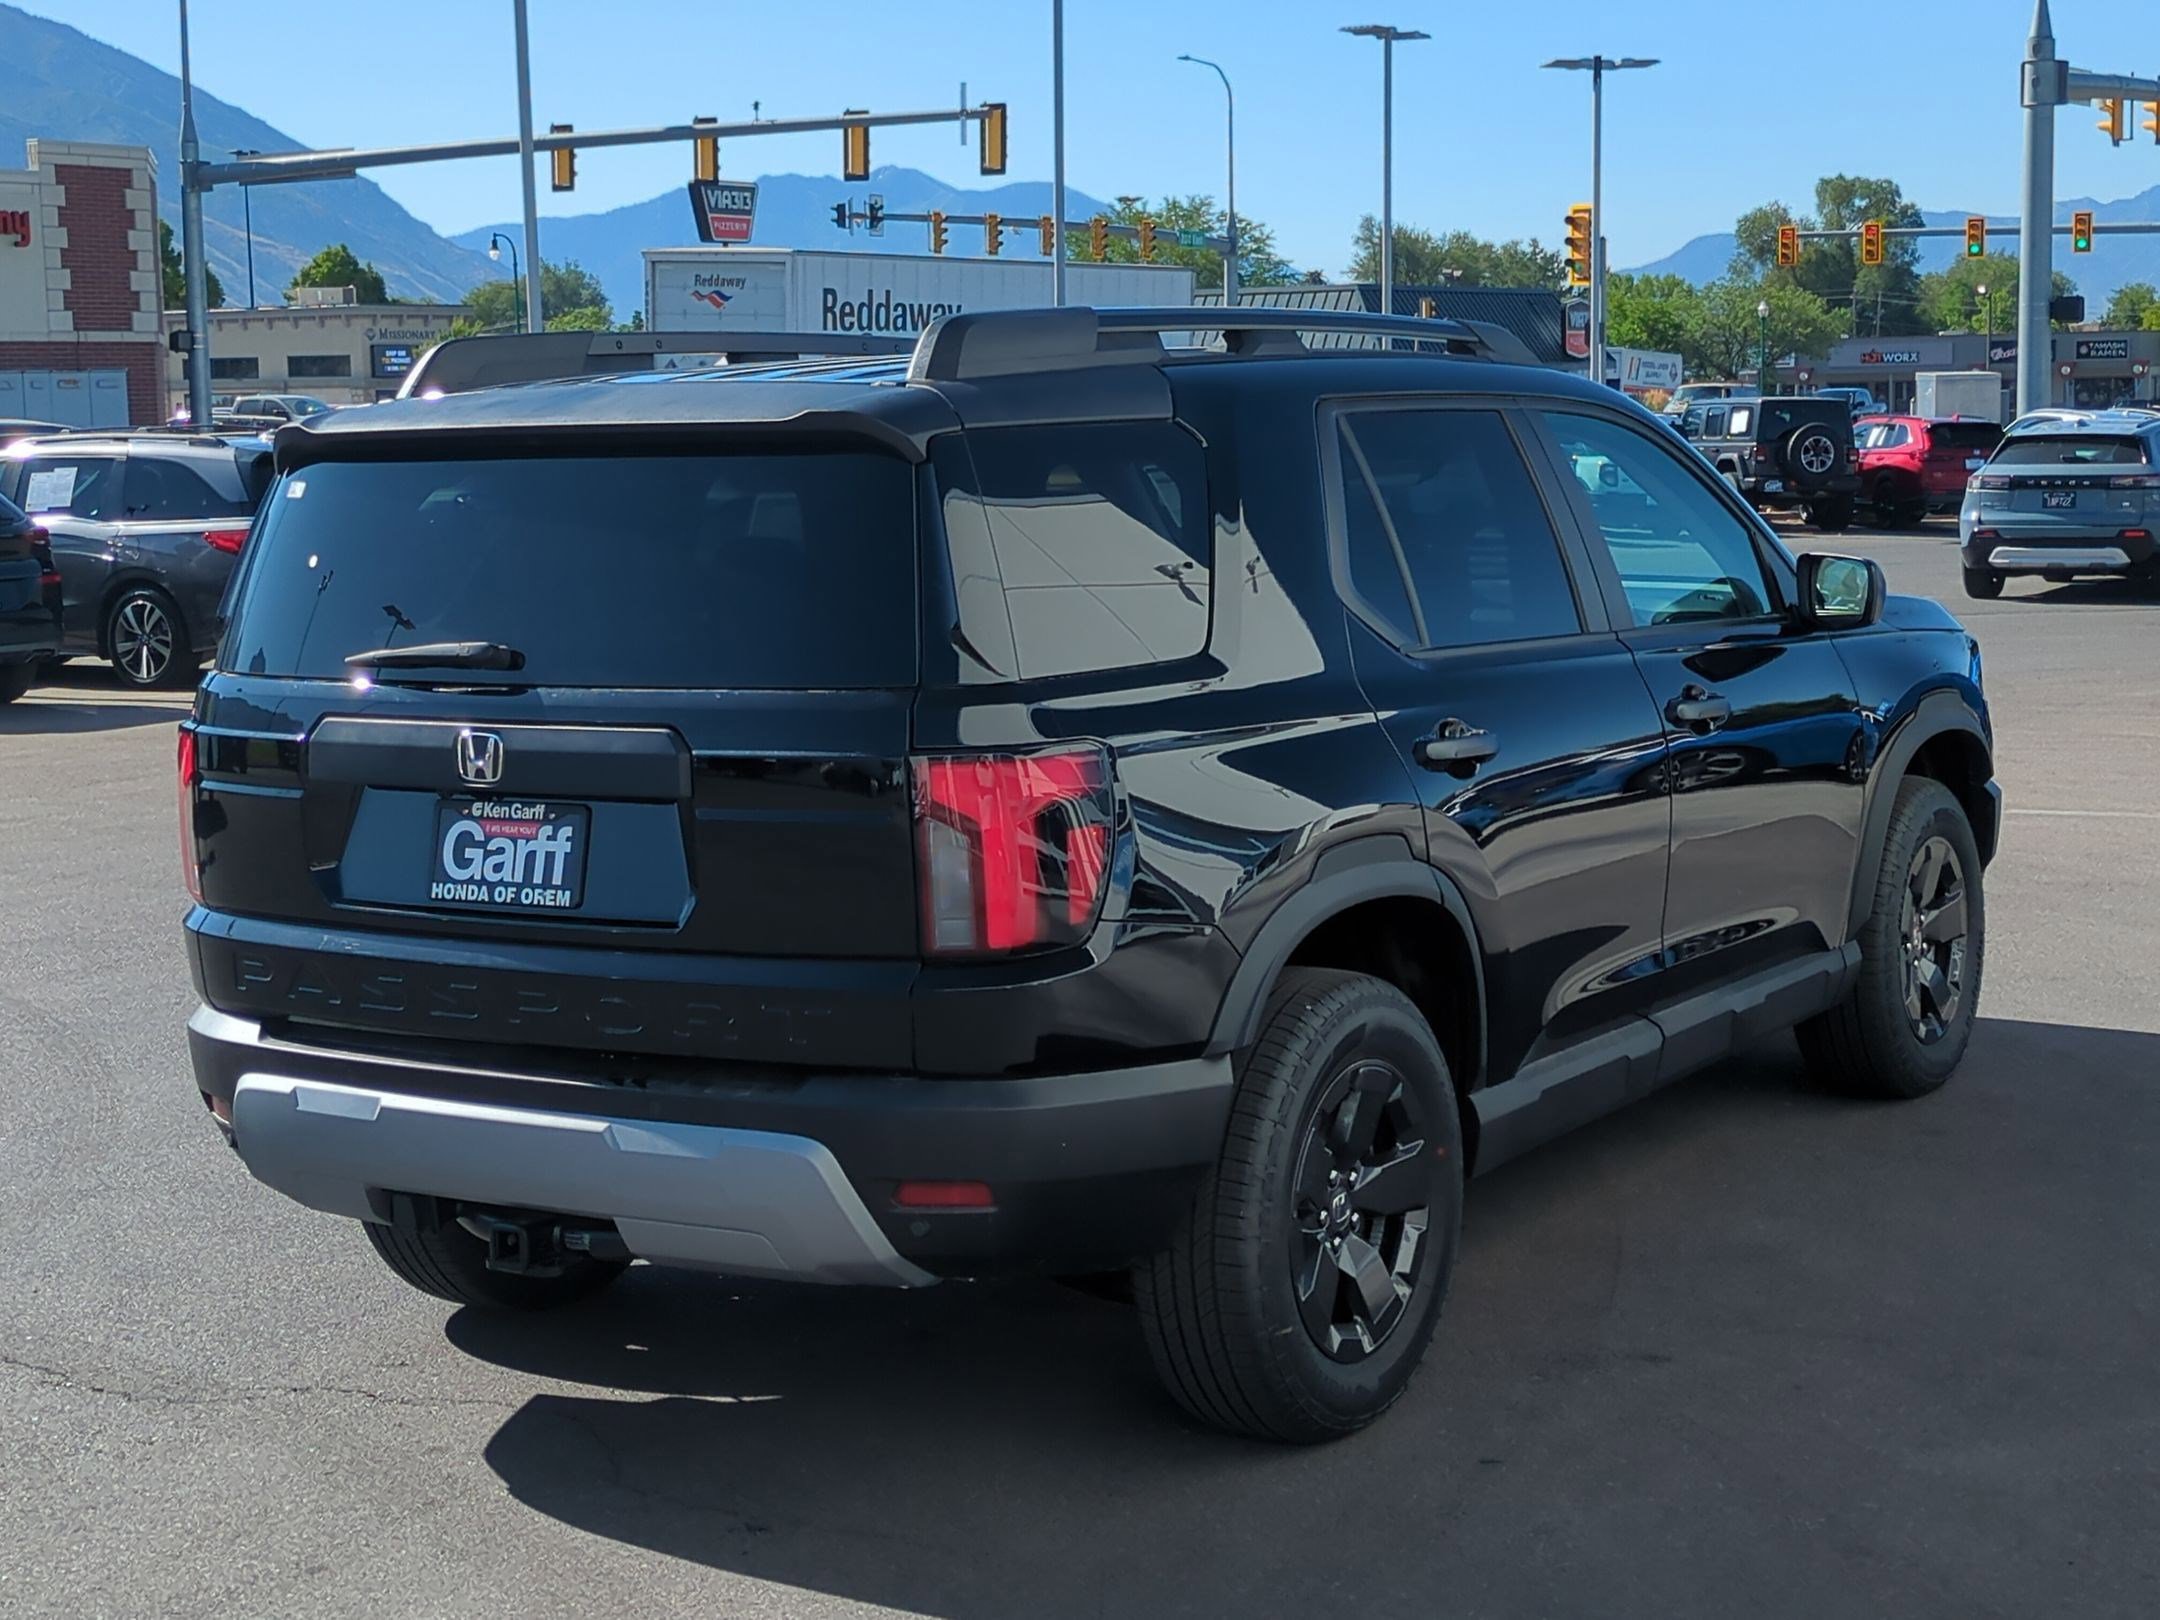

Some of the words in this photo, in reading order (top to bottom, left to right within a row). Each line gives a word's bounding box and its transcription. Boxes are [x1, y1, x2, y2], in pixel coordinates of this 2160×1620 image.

[694, 274, 746, 289] Reddaway
[483, 802, 510, 819] Ken
[511, 803, 546, 820] Garff
[443, 820, 573, 885] Garff
[431, 882, 489, 902] HONDA
[494, 886, 517, 904] OF
[520, 888, 571, 907] OREM
[234, 953, 833, 1045] PASSPORT
